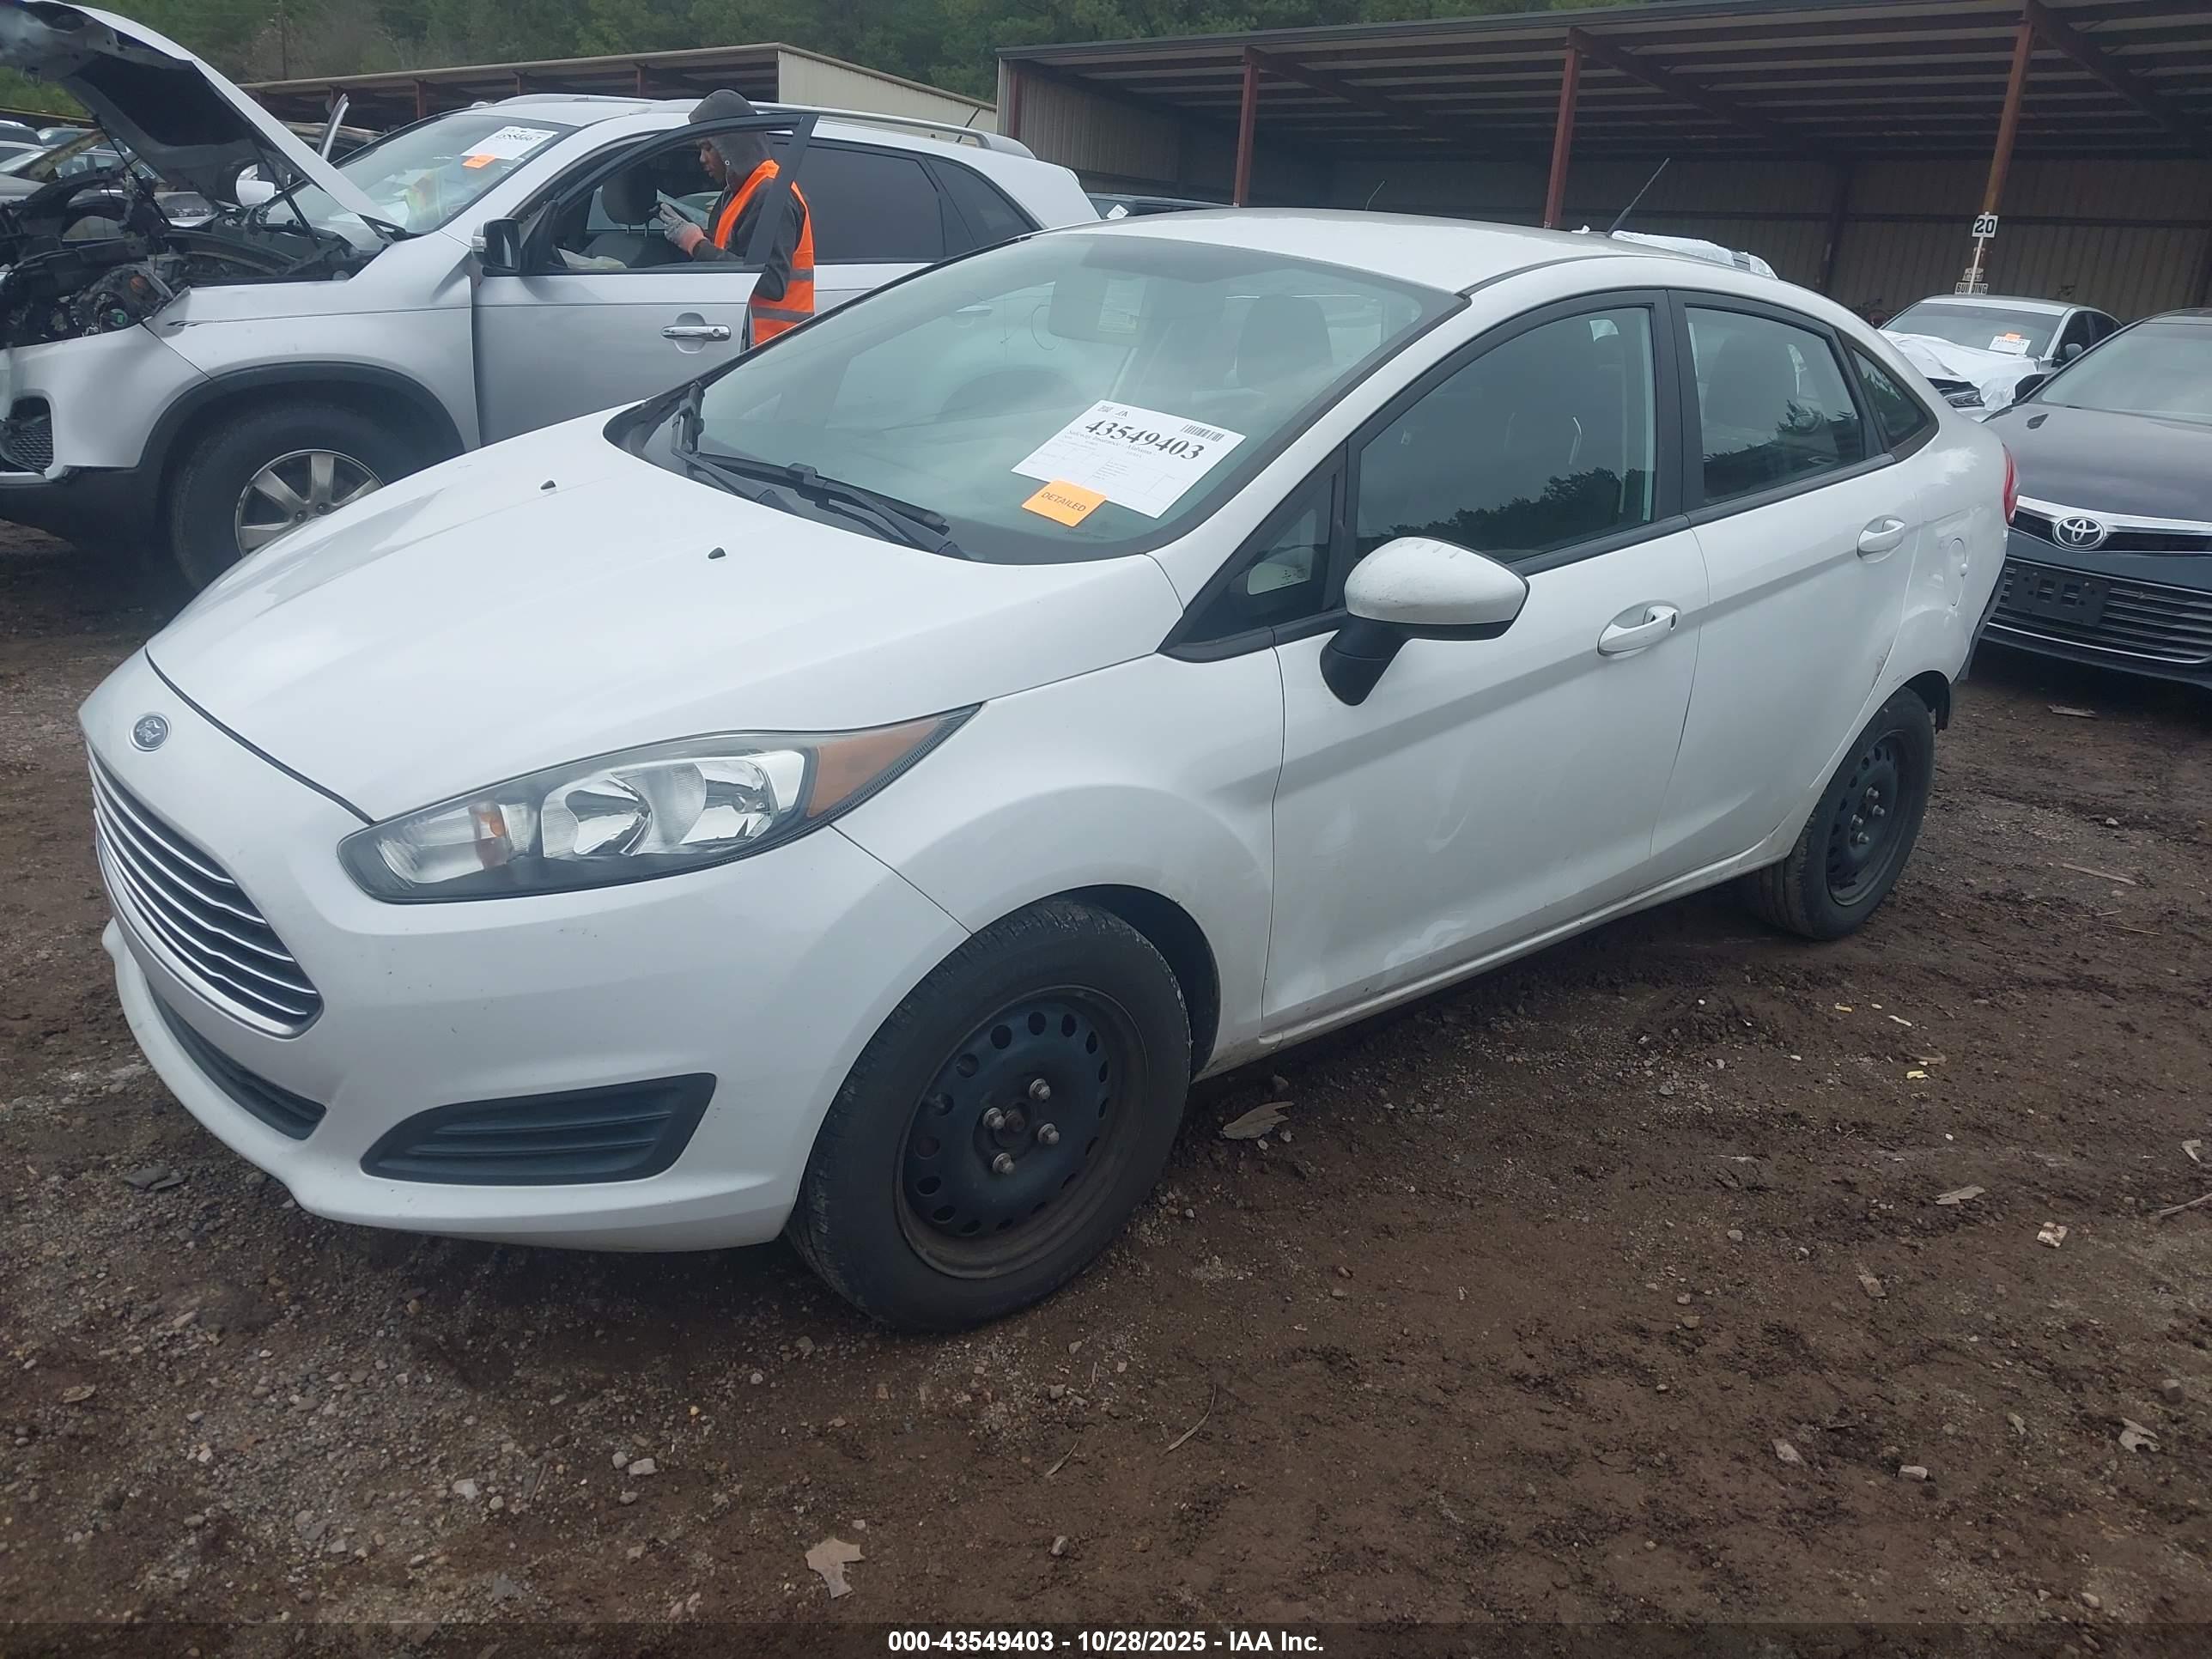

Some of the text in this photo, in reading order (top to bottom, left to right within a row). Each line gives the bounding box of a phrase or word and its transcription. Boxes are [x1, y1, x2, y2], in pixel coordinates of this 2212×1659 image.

[1975, 219, 1996, 234] 20
[1085, 420, 1205, 459] 43549403
[1041, 491, 1087, 513] DETAILED
